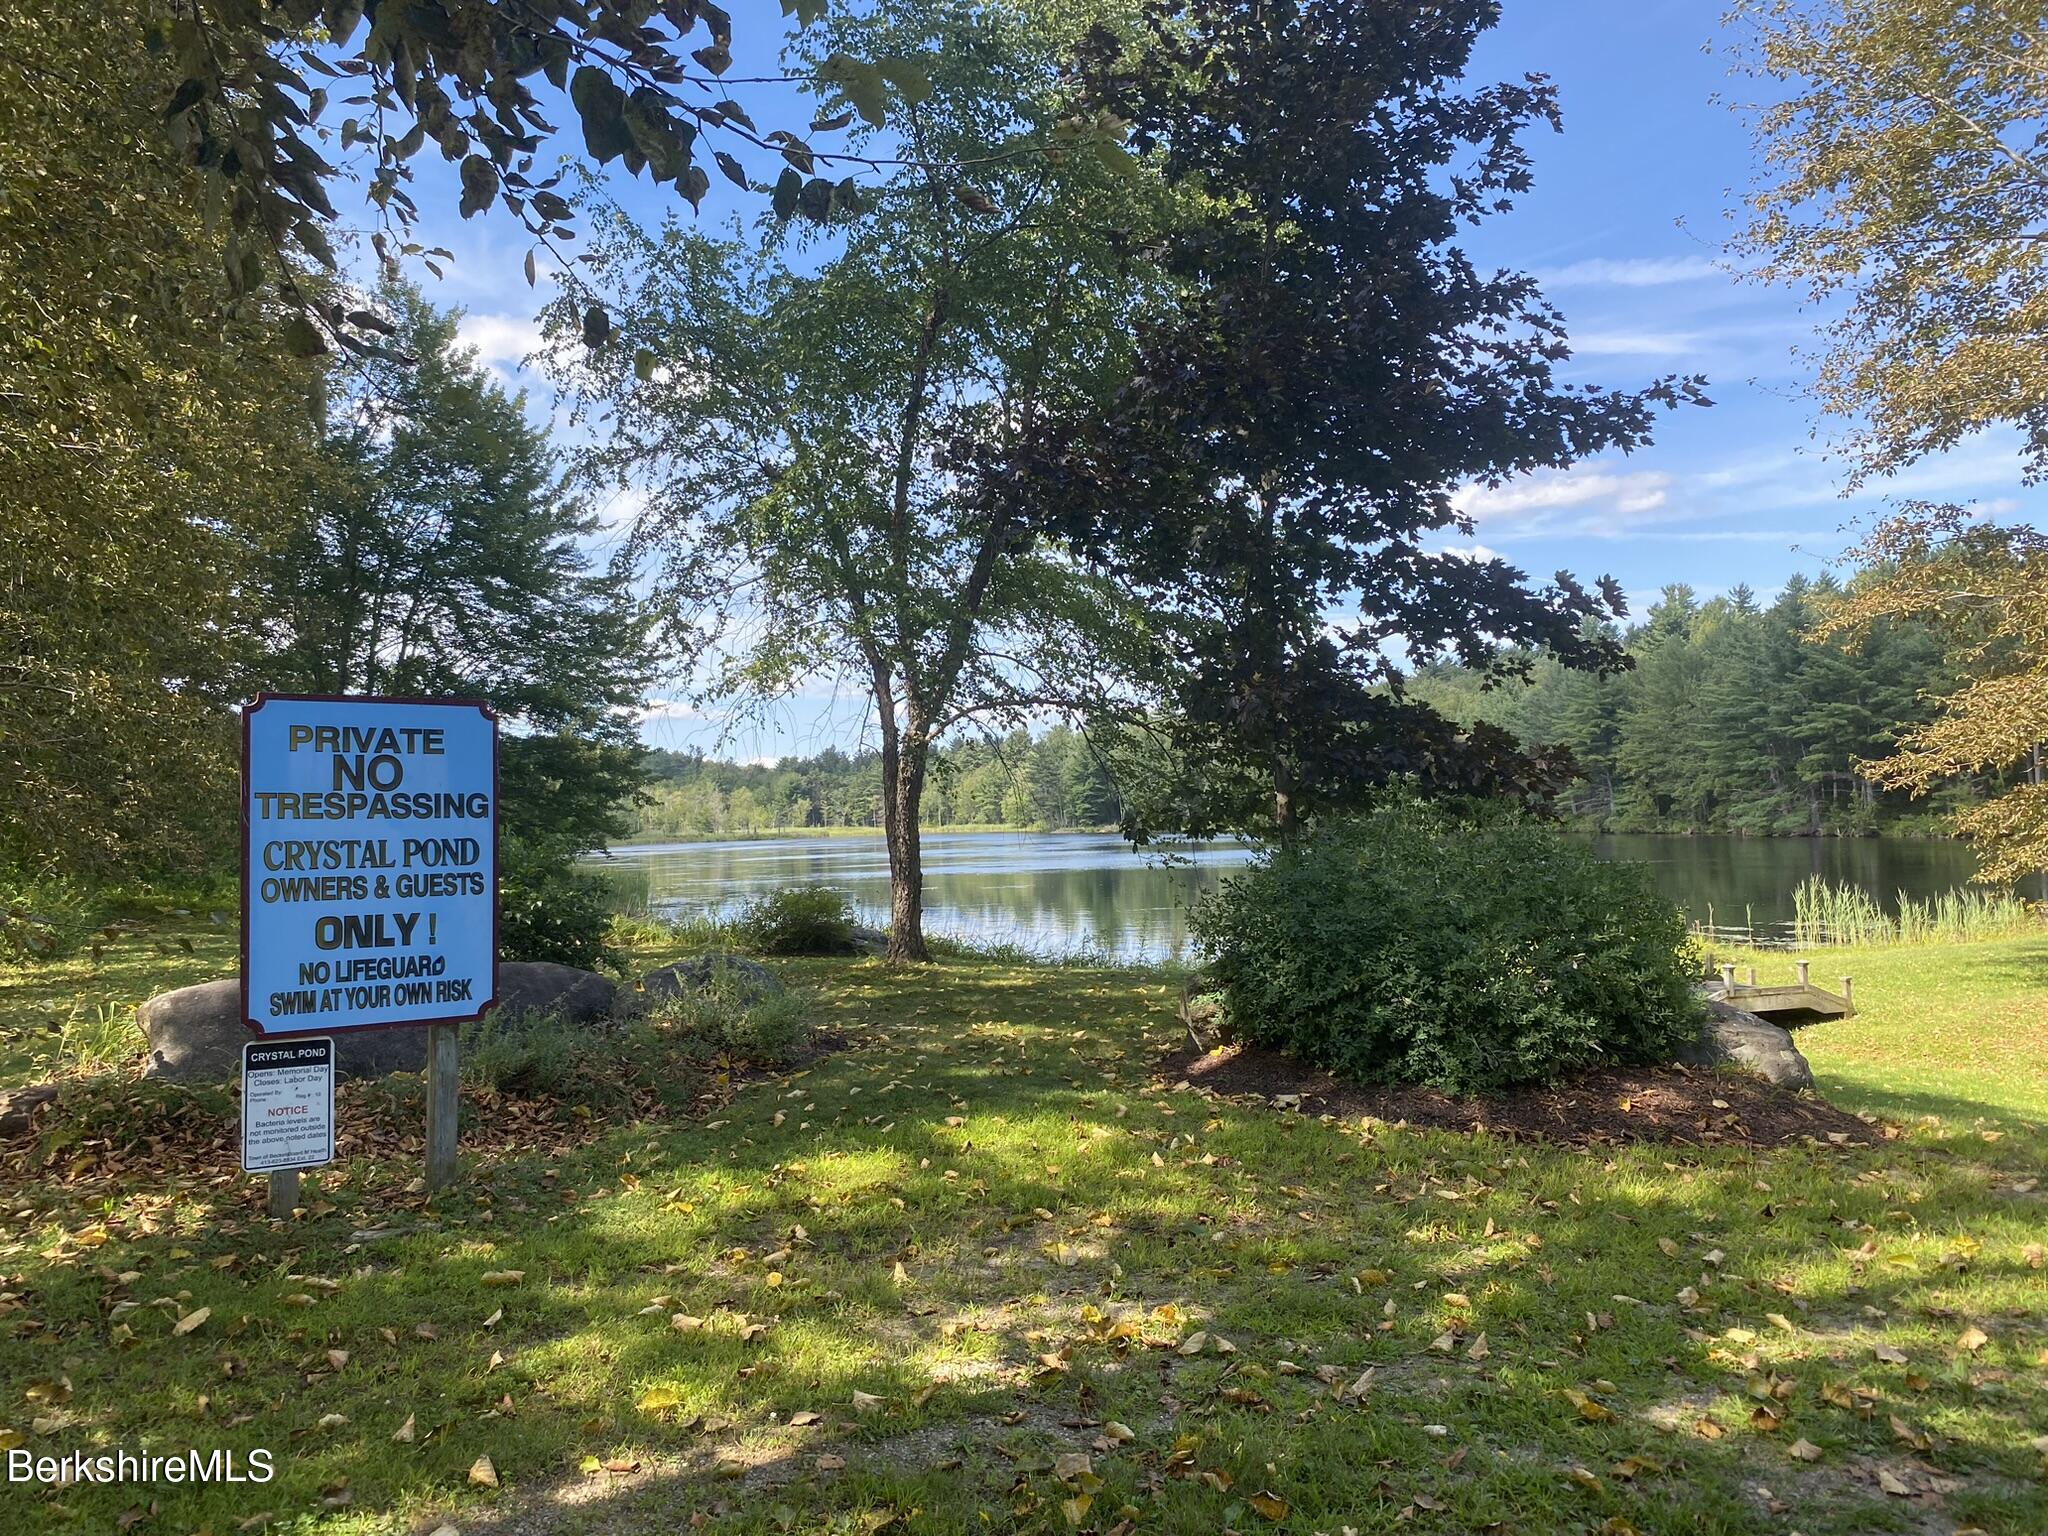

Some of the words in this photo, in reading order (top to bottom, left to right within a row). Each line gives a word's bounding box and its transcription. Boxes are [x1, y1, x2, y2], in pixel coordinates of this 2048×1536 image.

[289, 724, 445, 755] PRIVATE
[332, 754, 404, 792] NO
[254, 792, 489, 820] TRESPASSING
[263, 839, 397, 872] CRYSTAL
[402, 837, 481, 868] POND
[260, 875, 369, 903] OWNERS
[373, 874, 391, 899] &
[395, 871, 484, 898] GUESTS
[314, 912, 420, 950] ONLY
[299, 961, 331, 985] NO
[335, 955, 446, 983] LIFEGUARD
[269, 989, 316, 1017] SWIM
[319, 987, 342, 1012] AT
[344, 984, 391, 1010] YOUR
[393, 981, 432, 1006] OWN
[436, 978, 473, 1001] RISK
[250, 1050, 296, 1062] CRYSTAL
[298, 1048, 326, 1058] POND
[247, 1070, 274, 1079] Opens:
[277, 1066, 312, 1076] Memorial
[313, 1065, 329, 1074] Day
[284, 1076, 306, 1084] Labor
[307, 1075, 323, 1083] Day
[255, 1119, 286, 1128] Bacteria
[286, 1116, 308, 1125] levels
[267, 1105, 309, 1117] NOTICE
[249, 1129, 262, 1137] not
[263, 1125, 299, 1136] monitored
[300, 1123, 326, 1131] outside
[261, 1136, 285, 1145] above
[285, 1133, 306, 1141] noted
